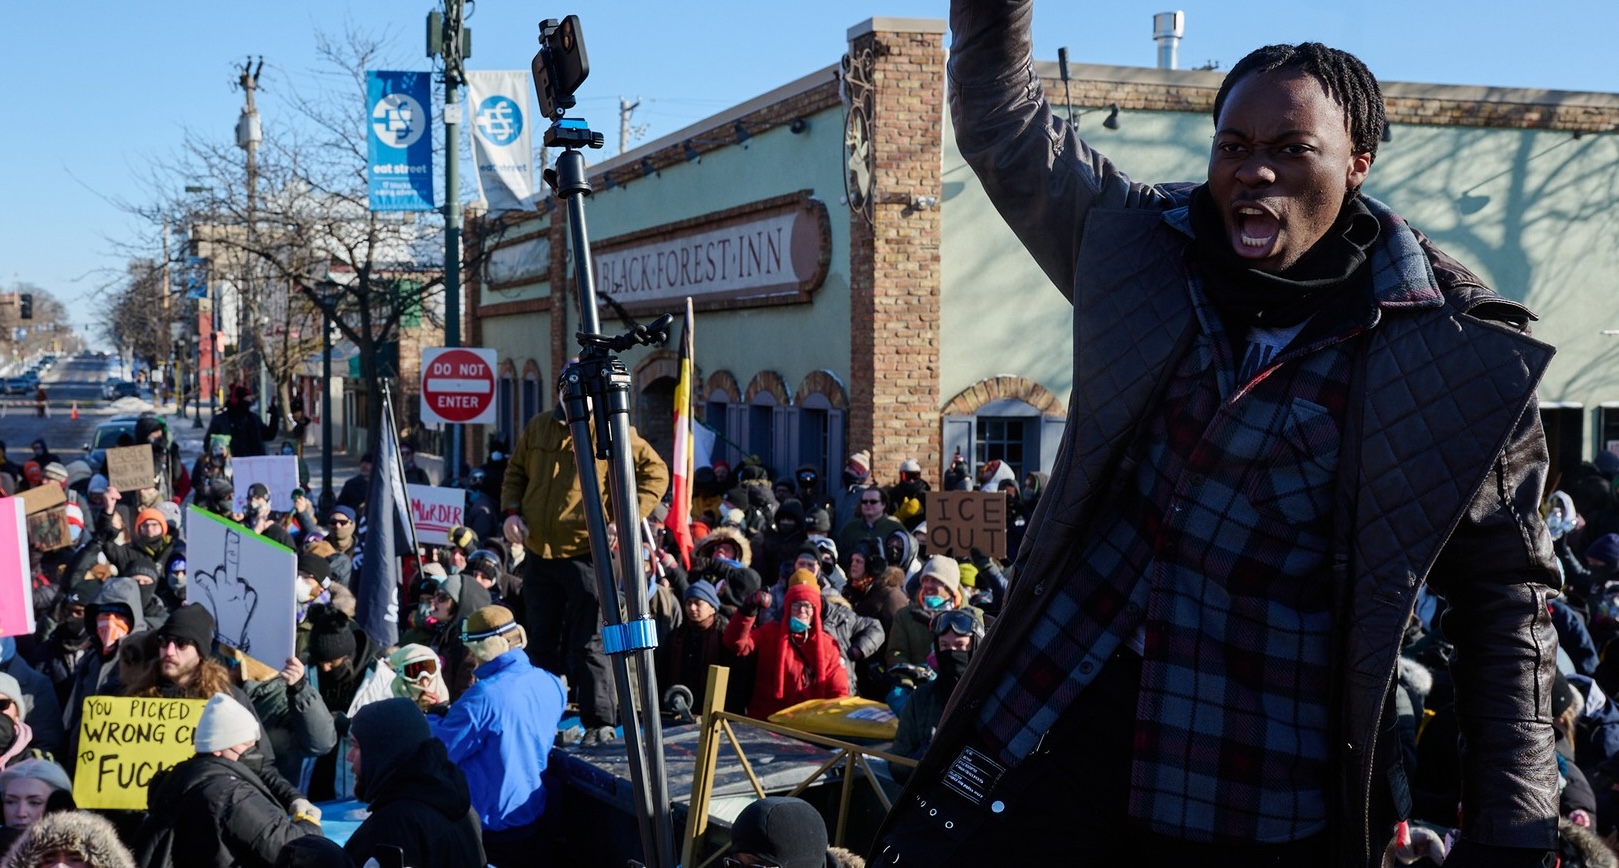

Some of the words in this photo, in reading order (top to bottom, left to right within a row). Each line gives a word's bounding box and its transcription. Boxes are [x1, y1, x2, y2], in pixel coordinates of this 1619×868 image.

[373, 163, 392, 174] eat
[393, 163, 427, 174] street
[602, 254, 652, 294] BLACK
[656, 238, 731, 289] FOREST
[738, 228, 783, 278] INN
[433, 363, 452, 376] DO
[459, 363, 485, 376] NOT
[437, 395, 479, 409] ENTER
[411, 498, 462, 526] MURDER
[938, 497, 1003, 523] ICE
[931, 525, 1002, 554] OUT
[87, 699, 112, 720] YOU
[130, 699, 190, 721] PICKED
[84, 721, 166, 747] WRONG
[80, 750, 95, 766] TO
